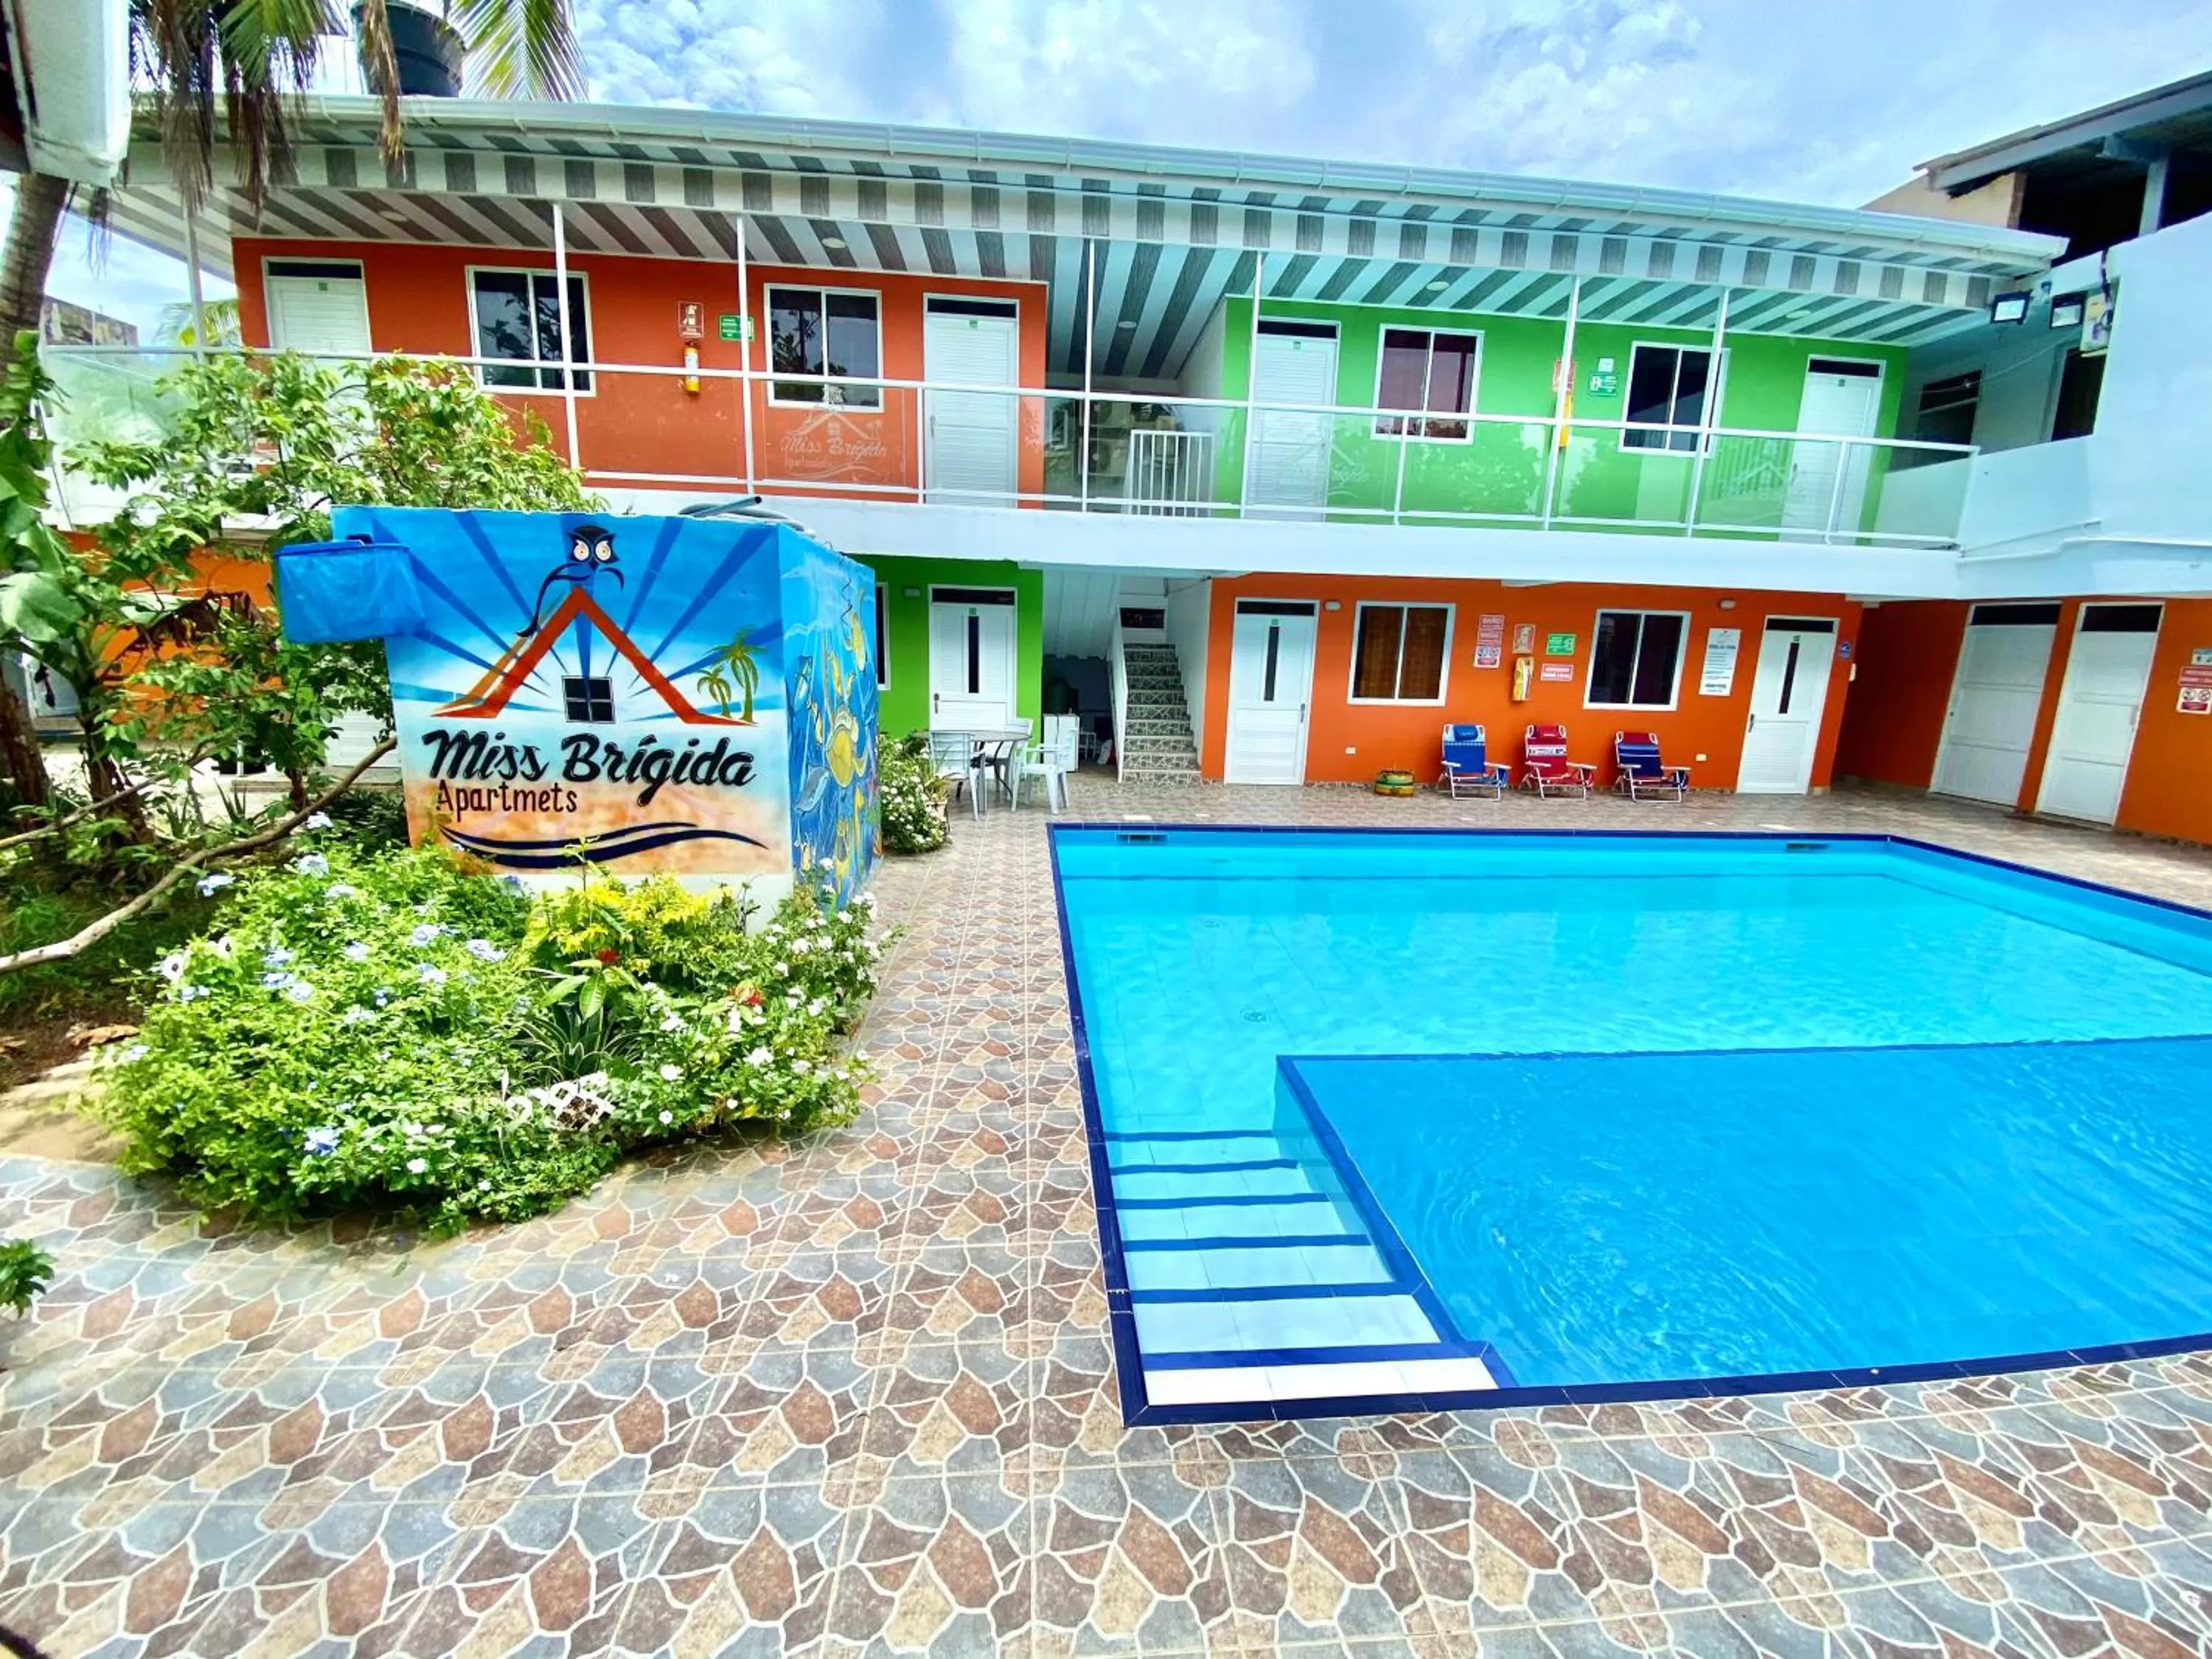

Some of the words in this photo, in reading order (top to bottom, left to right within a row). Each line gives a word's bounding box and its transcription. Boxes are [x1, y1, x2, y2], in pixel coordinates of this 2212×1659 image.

[422, 730, 550, 782] Miss
[561, 733, 757, 807] Brígida
[437, 779, 577, 822] Apartmets
